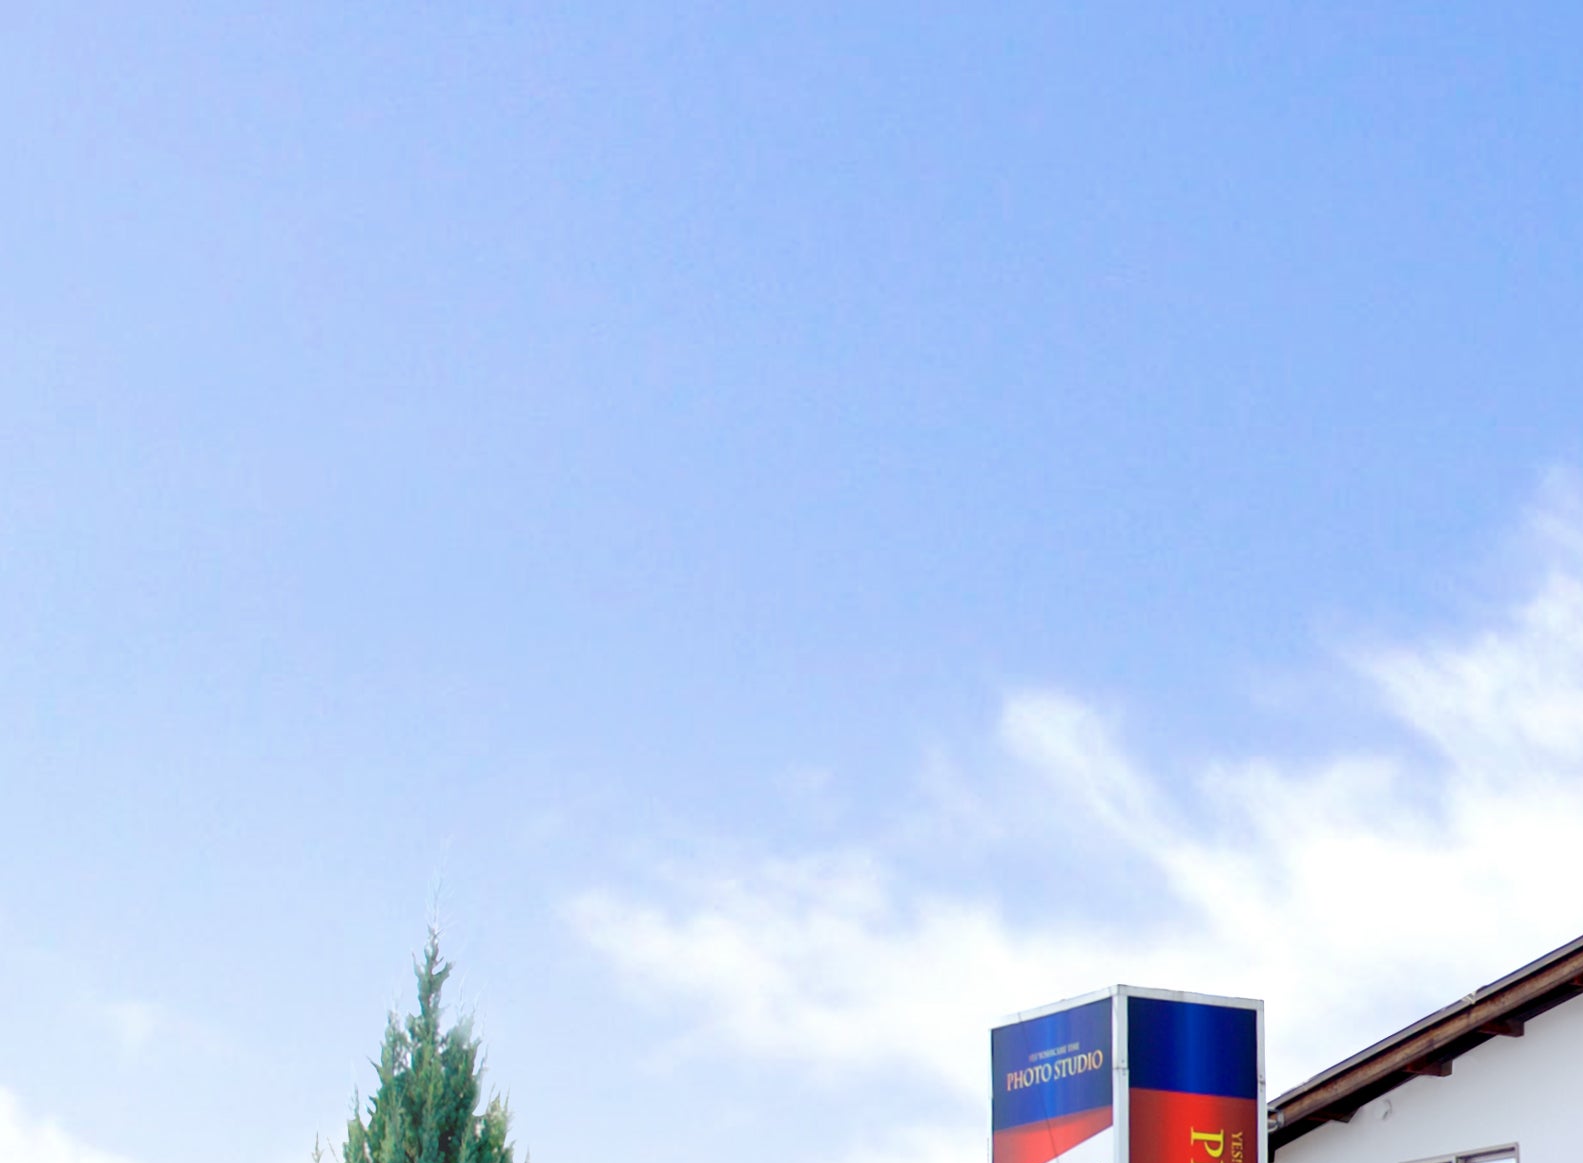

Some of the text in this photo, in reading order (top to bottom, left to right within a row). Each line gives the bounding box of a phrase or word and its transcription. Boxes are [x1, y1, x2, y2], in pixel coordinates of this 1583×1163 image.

[1007, 1063, 1052, 1091] PHOTO
[1054, 1049, 1103, 1080] STUDIO
[1231, 1131, 1243, 1163] YES!
